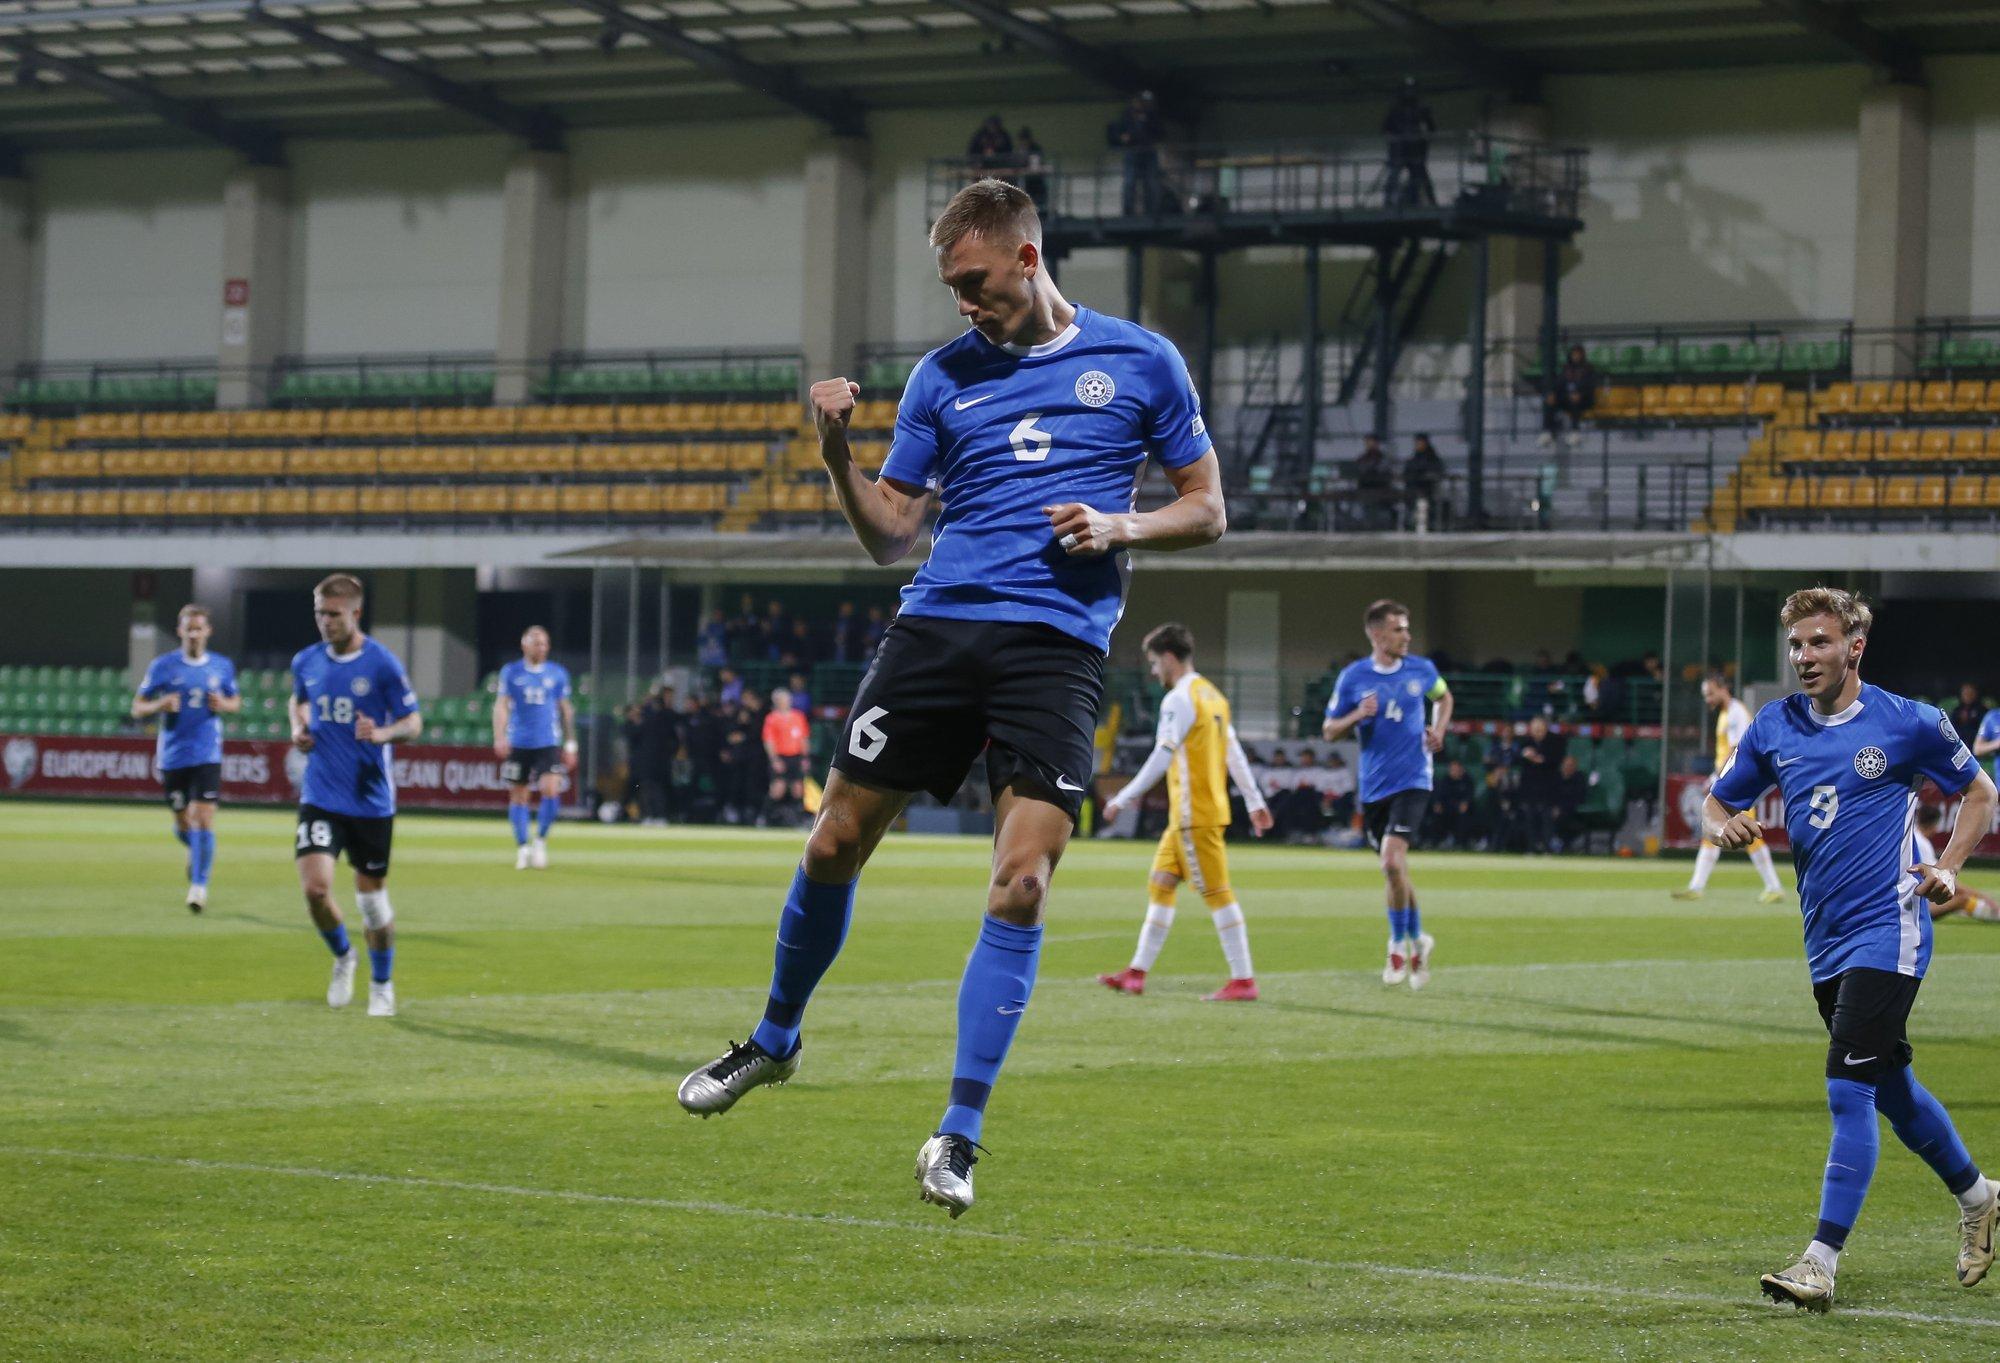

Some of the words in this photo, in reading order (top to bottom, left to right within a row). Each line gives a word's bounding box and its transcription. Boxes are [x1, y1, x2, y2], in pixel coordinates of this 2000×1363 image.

[1008, 412, 1052, 461] 6
[188, 687, 203, 709] 2
[316, 695, 353, 724] 18
[1384, 699, 1403, 722] 4
[849, 705, 889, 763] 6
[42, 751, 149, 780] EUROPEAN
[1809, 786, 1839, 829] 9
[296, 820, 332, 849] 18
